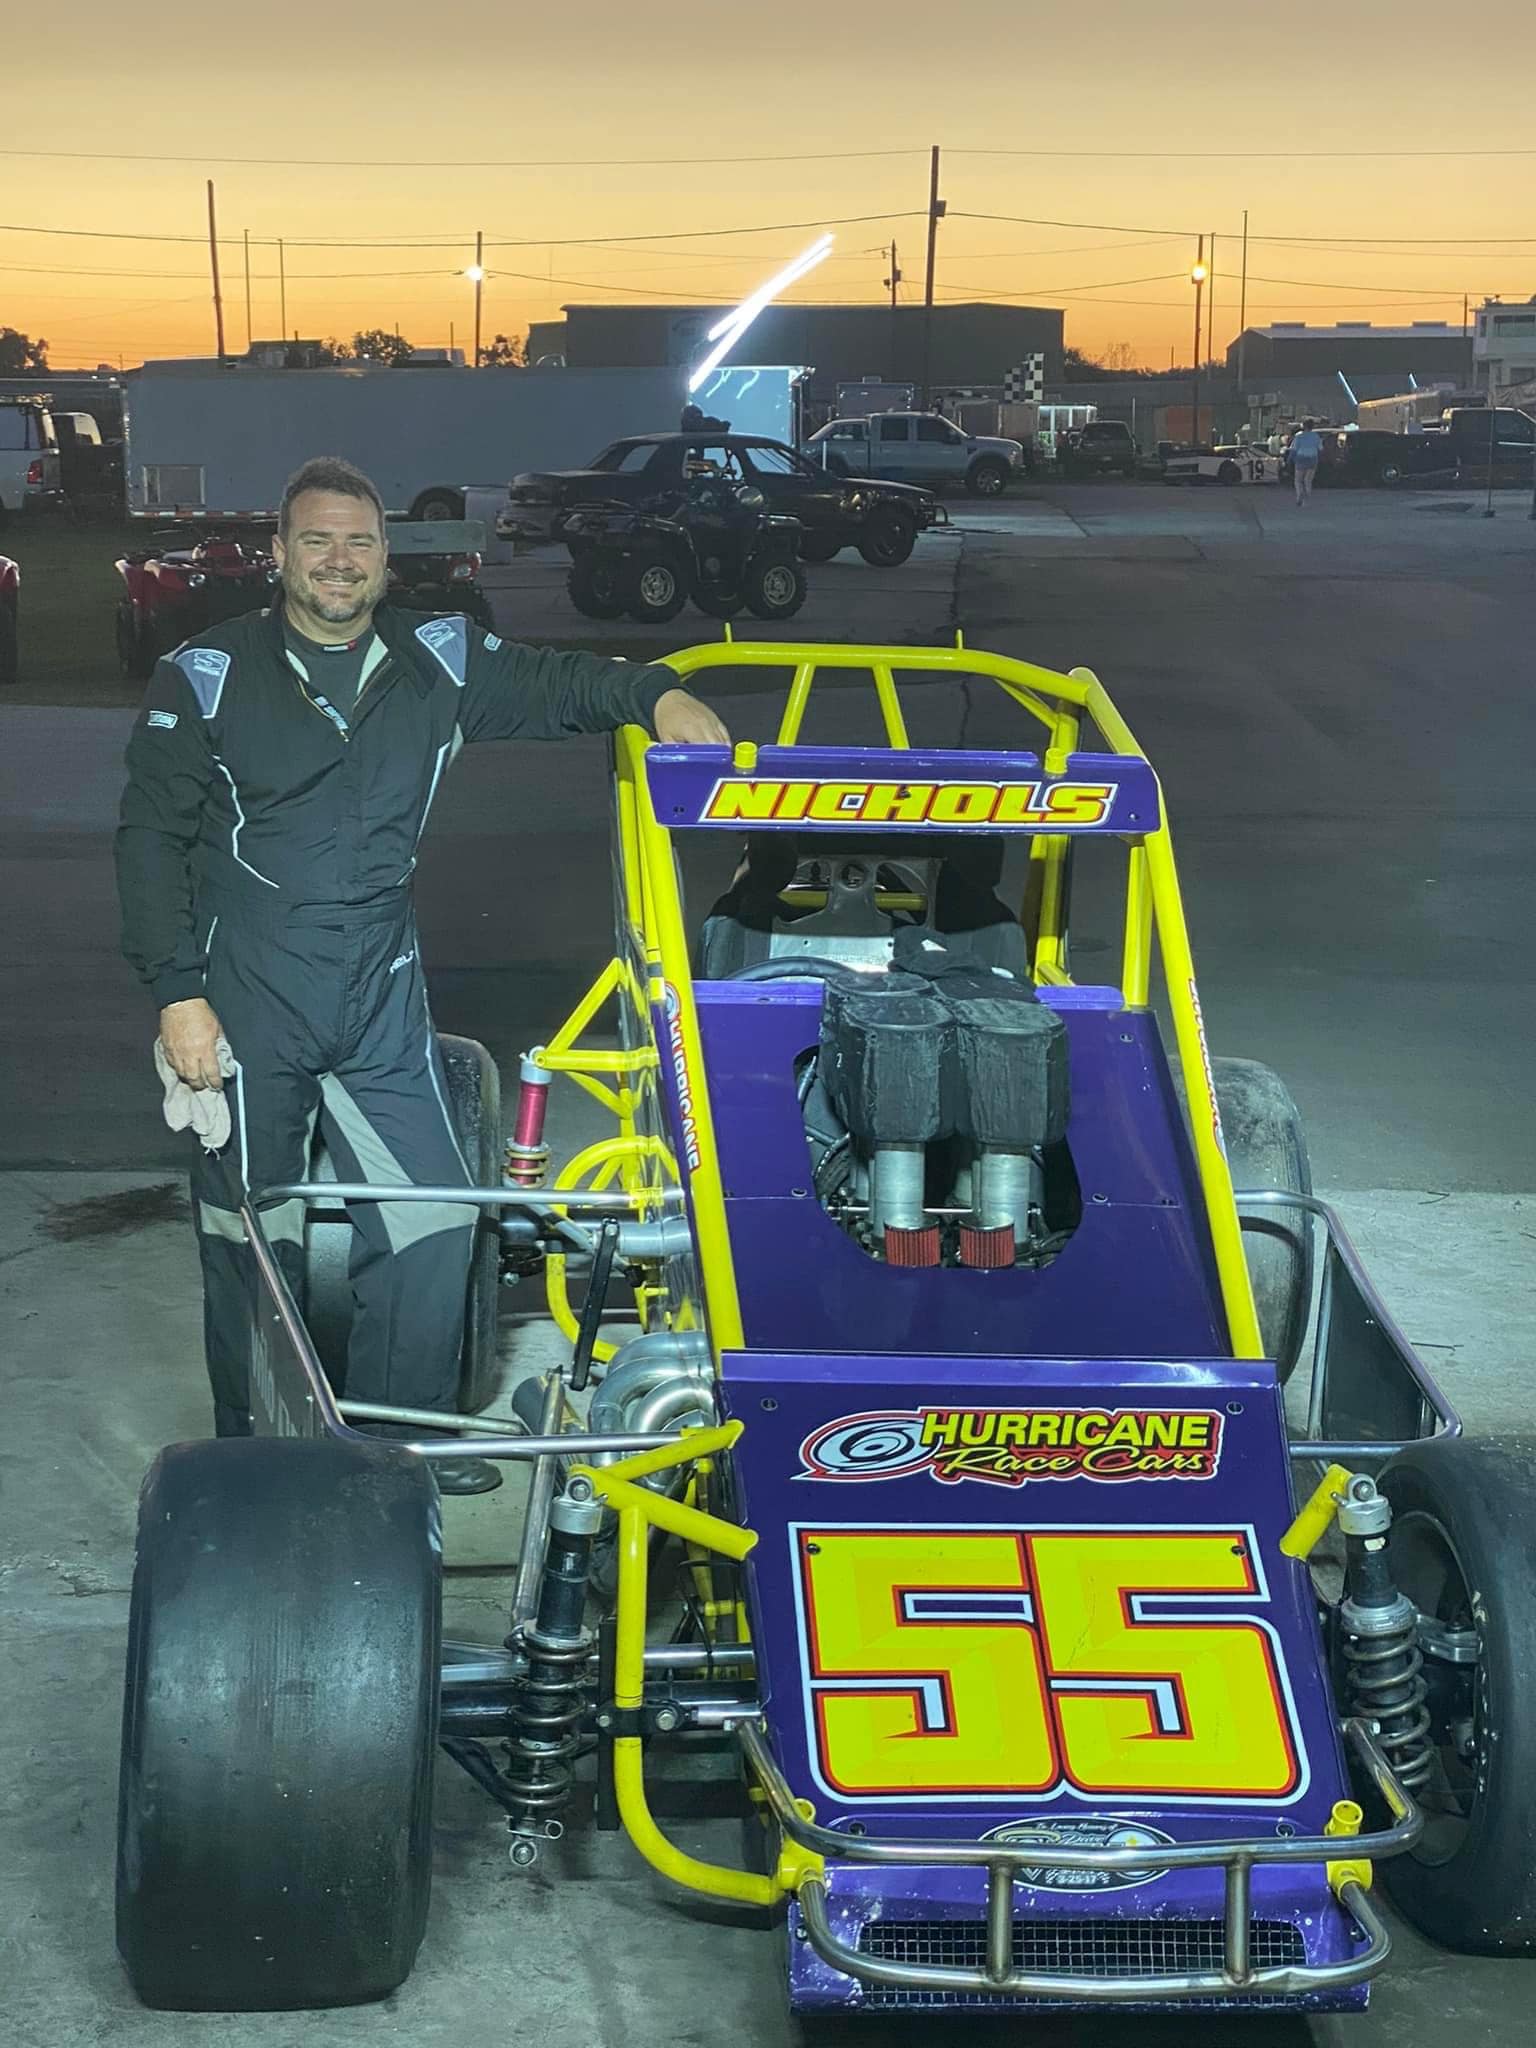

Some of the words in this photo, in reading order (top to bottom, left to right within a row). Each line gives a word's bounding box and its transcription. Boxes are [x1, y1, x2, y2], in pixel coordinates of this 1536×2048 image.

[701, 780, 1117, 824] NICHOLS
[921, 1412, 1210, 1447] HURRICANE
[934, 1446, 1078, 1478] Race
[1083, 1446, 1202, 1473] Cars
[799, 1530, 1304, 1798] 55
